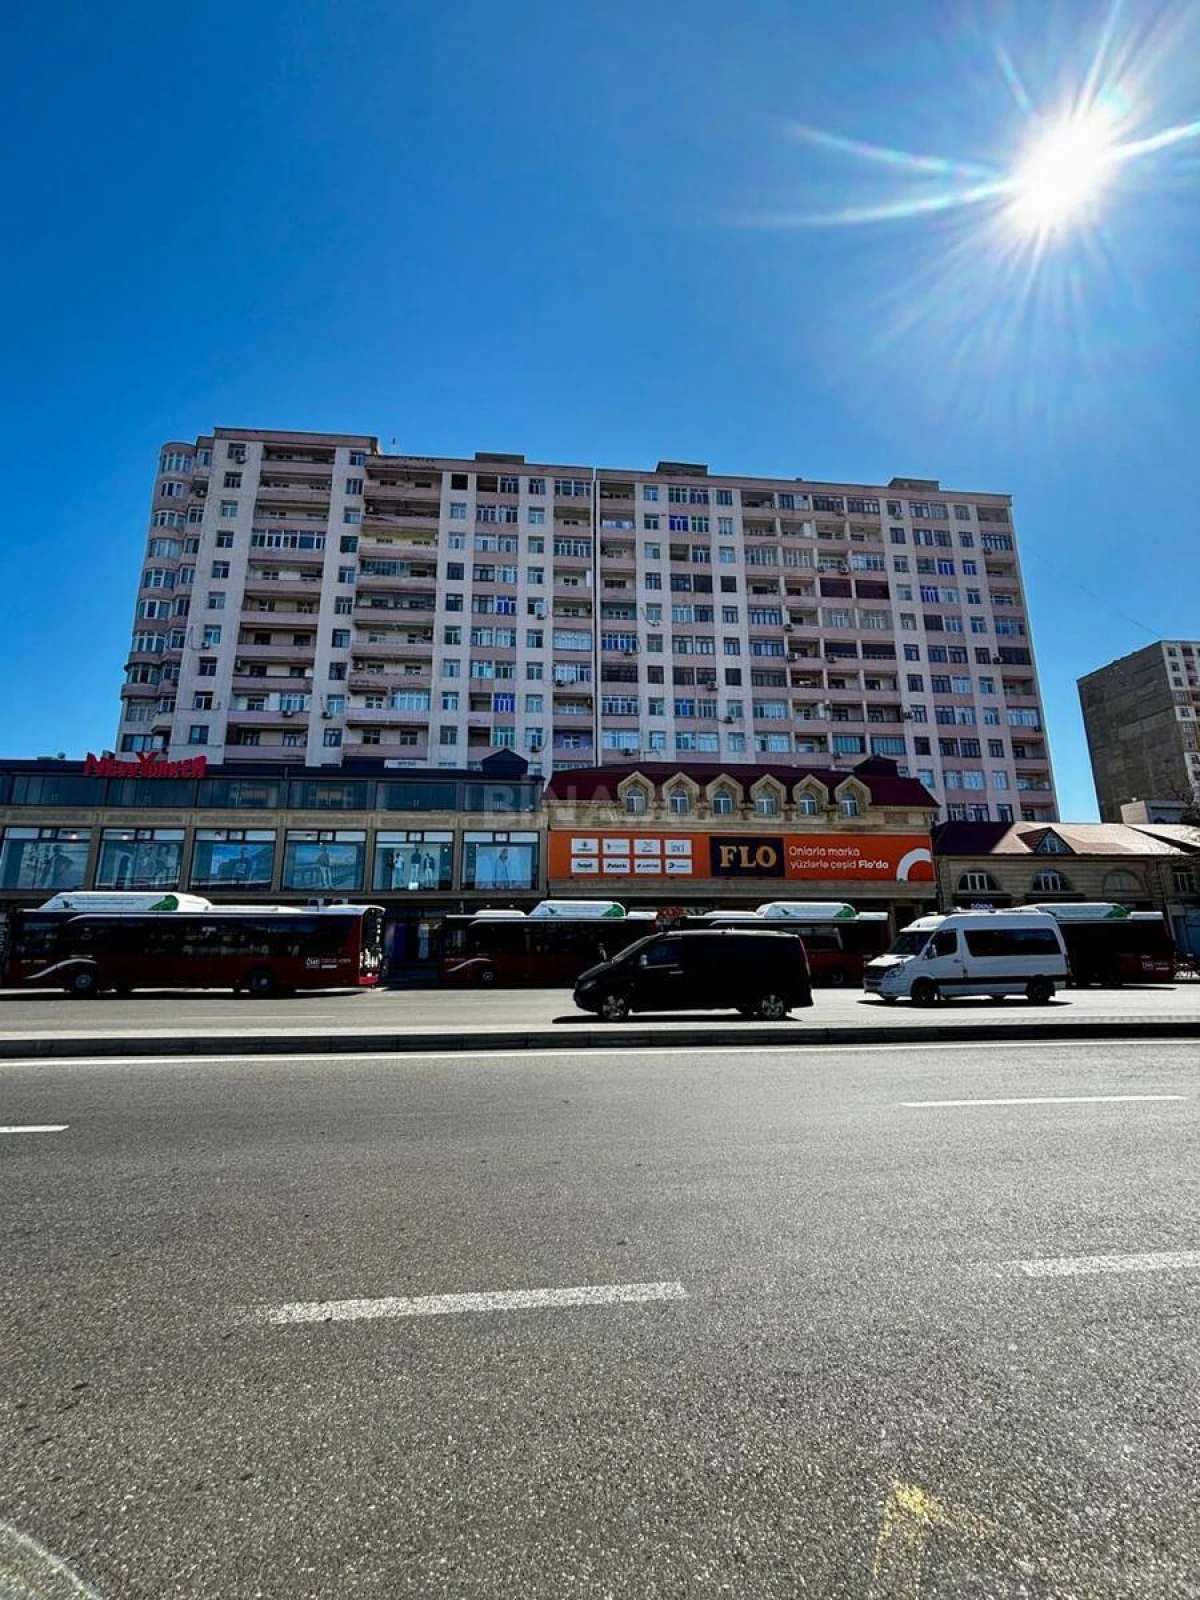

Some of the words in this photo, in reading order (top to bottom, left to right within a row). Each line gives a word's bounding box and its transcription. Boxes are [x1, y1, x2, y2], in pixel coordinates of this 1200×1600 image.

[788, 846, 826, 856] Onlarla
[827, 847, 861, 856] marka
[720, 845, 777, 868] FLO
[858, 860, 889, 869] Flo'da
